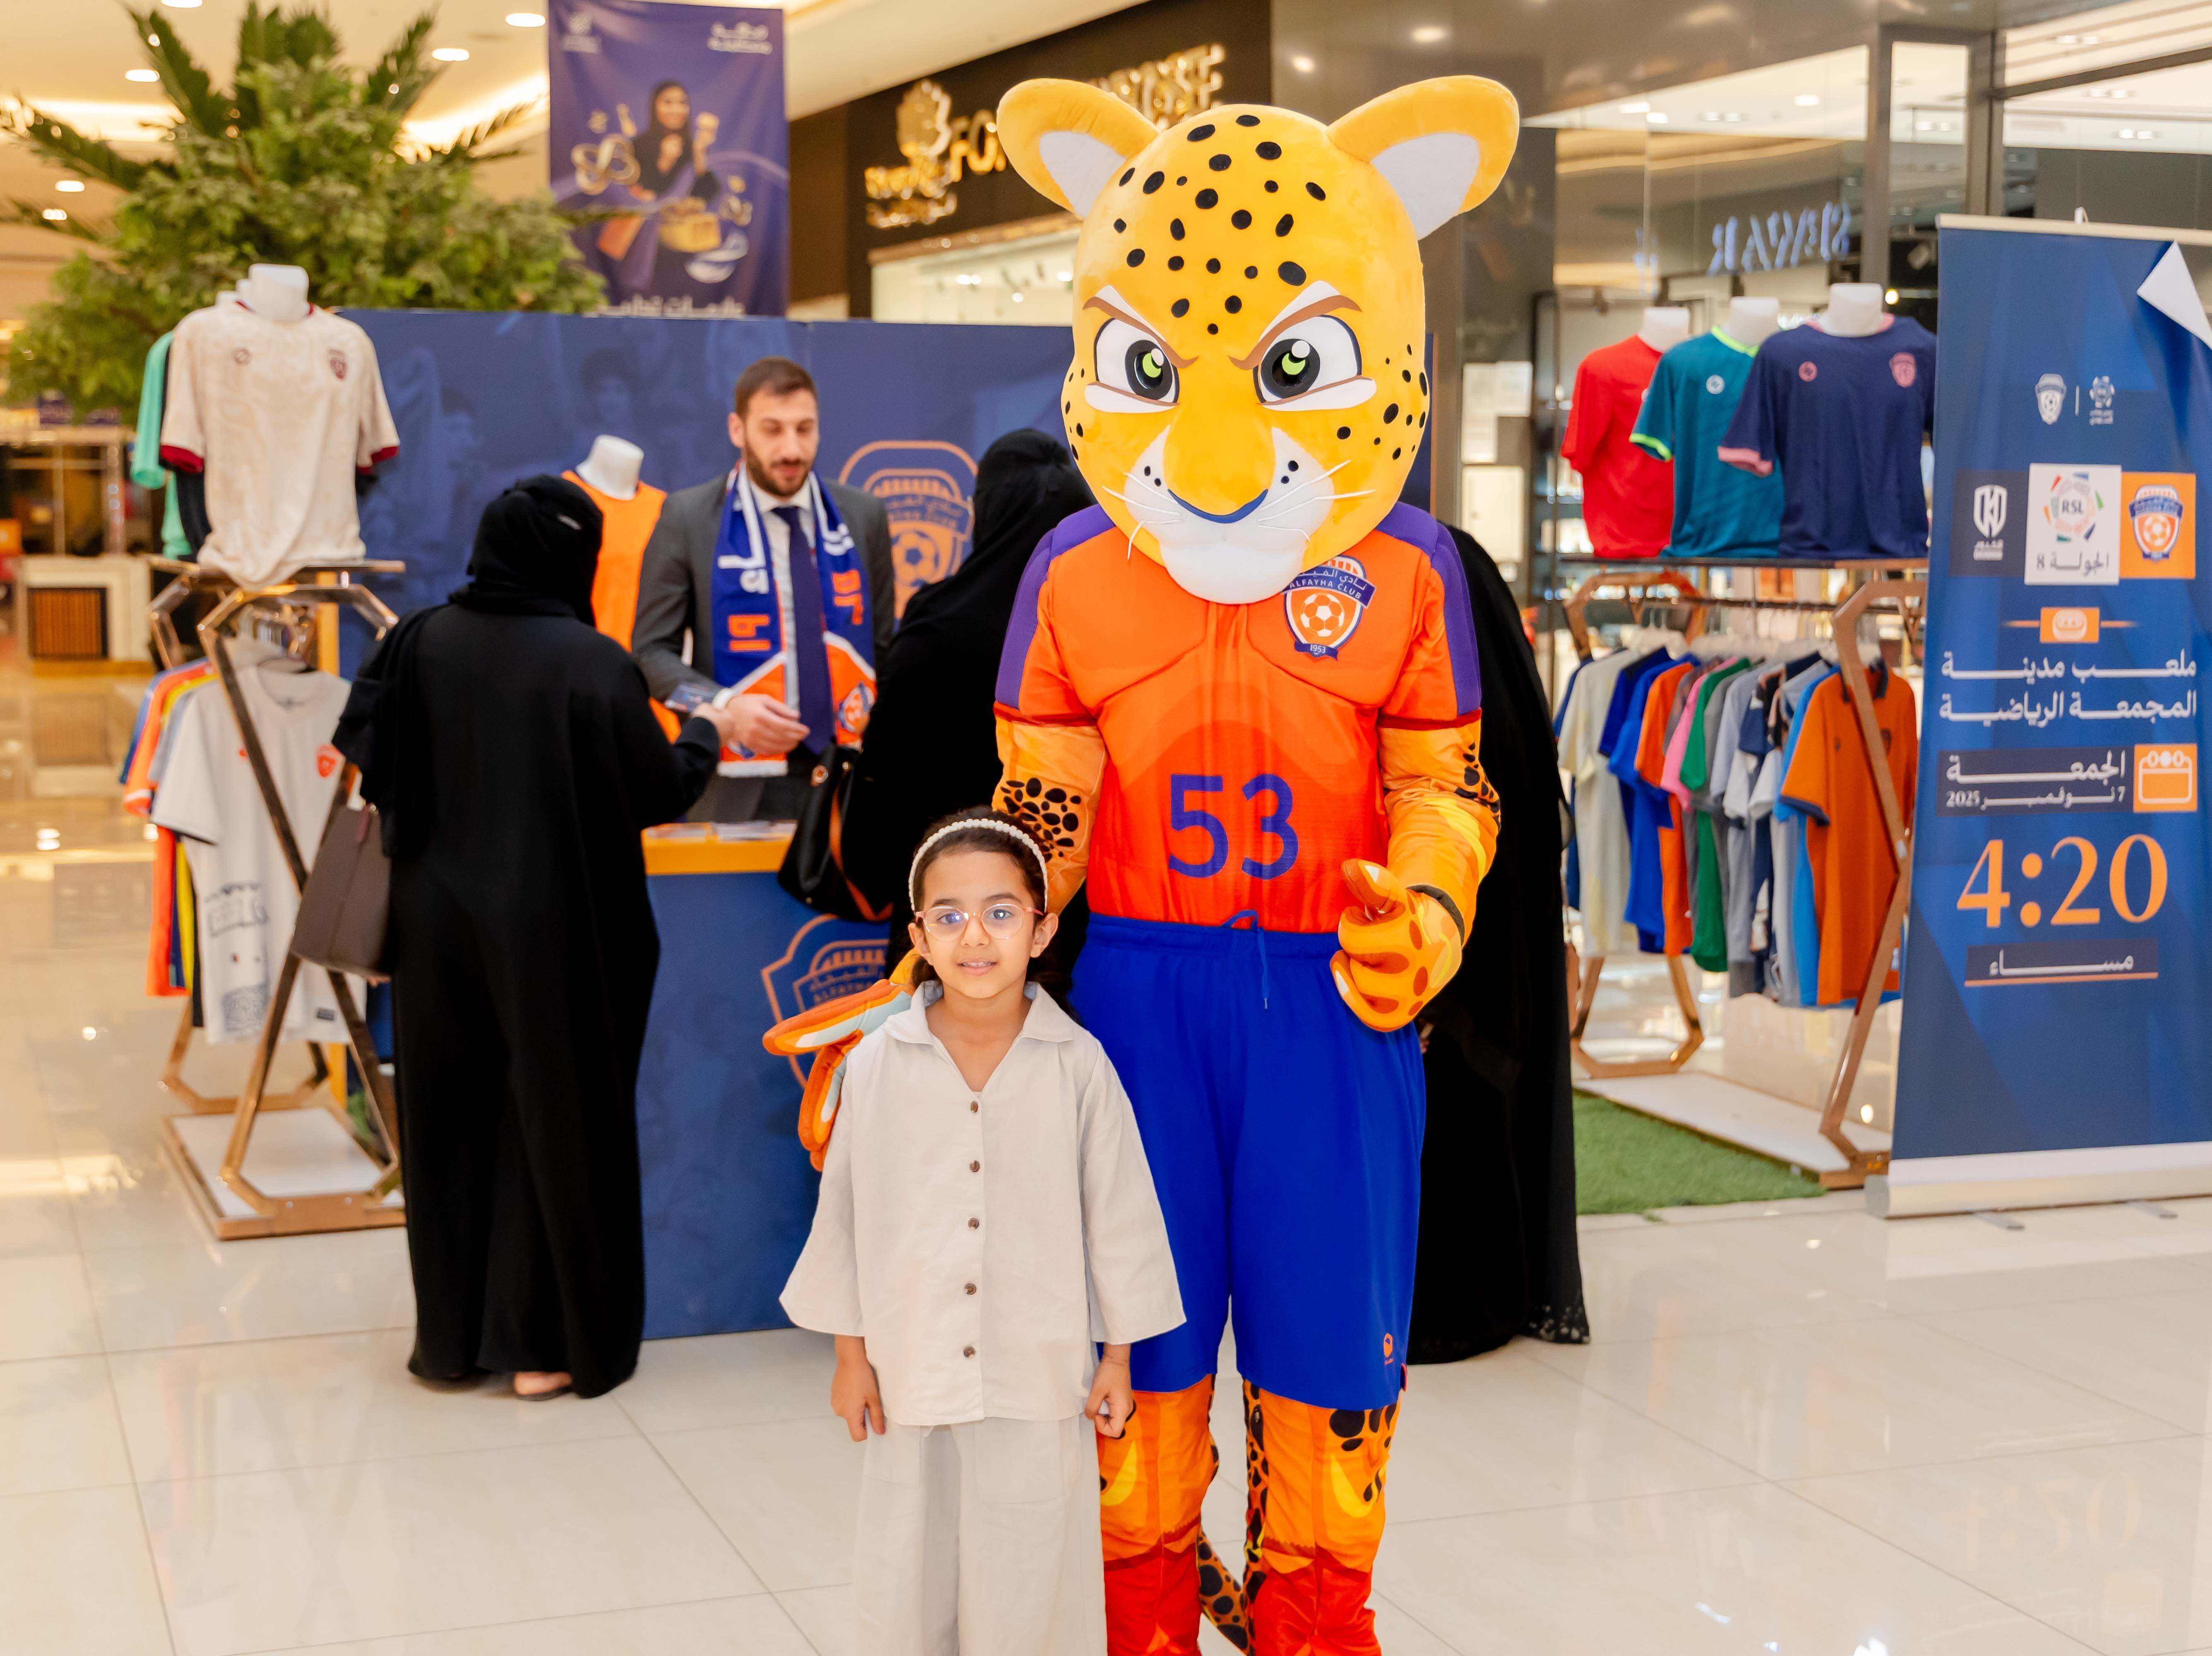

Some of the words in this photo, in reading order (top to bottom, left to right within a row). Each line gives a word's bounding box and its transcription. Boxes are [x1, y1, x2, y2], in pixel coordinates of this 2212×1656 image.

[2062, 499, 2084, 514] RSL
[2036, 554, 2046, 570] 8
[2050, 551, 2109, 576] الجولة
[1337, 583, 1362, 599] CLUB
[1339, 575, 1367, 591] نادي
[1310, 644, 1326, 653] 1953
[1941, 649, 2065, 684] مدينة
[2071, 648, 2196, 682] ملعب
[1939, 691, 2064, 728] الرياضية
[2069, 691, 2196, 724] المجمعة
[1947, 749, 2126, 786] الجمعة
[1946, 790, 1981, 808] 2025
[1981, 785, 2115, 811] نوفمبر
[1169, 773, 1299, 880] 53
[1957, 833, 2167, 929] 4:20
[1989, 949, 2134, 977] مساء
